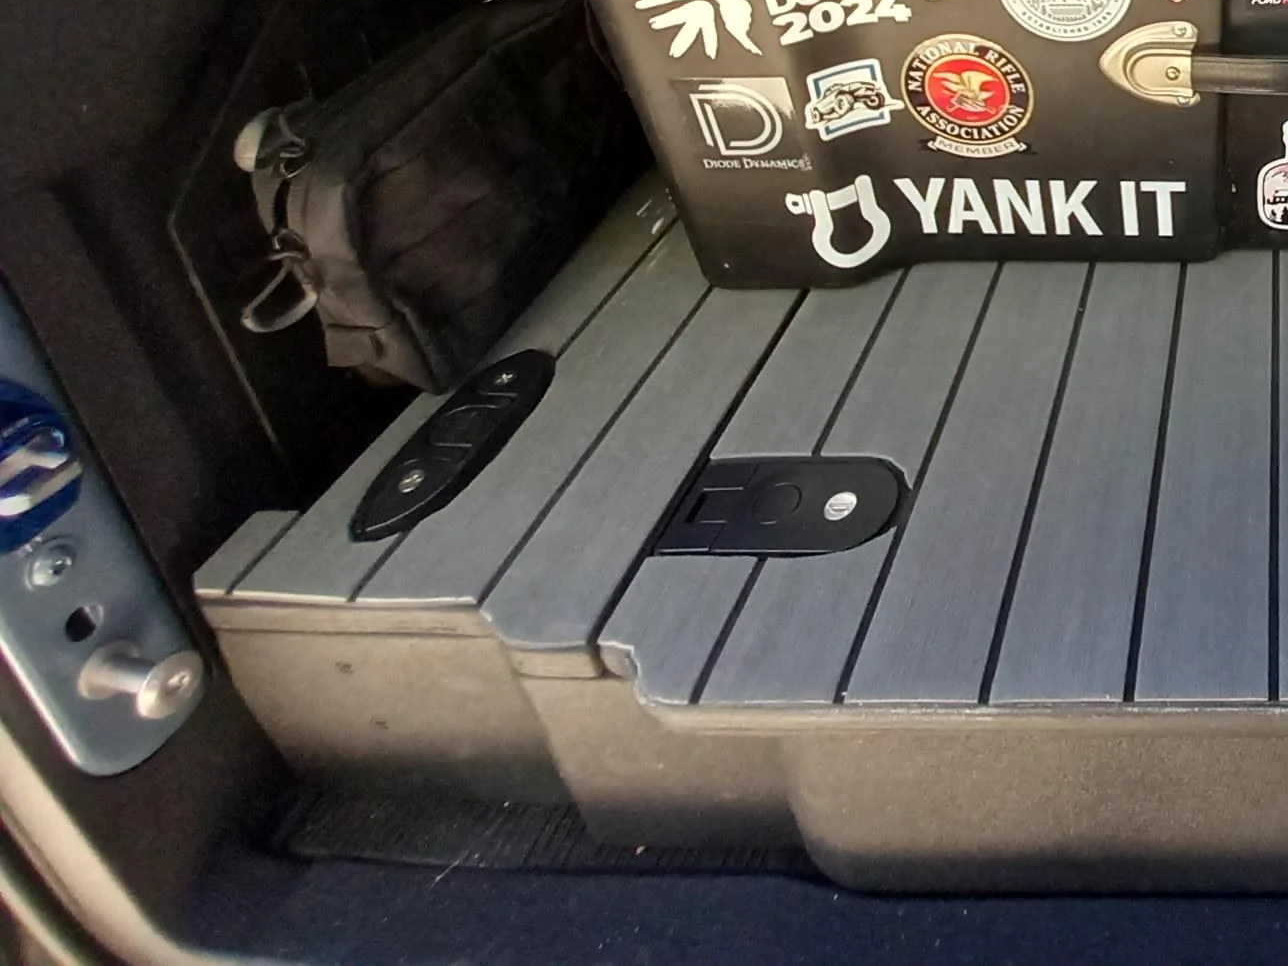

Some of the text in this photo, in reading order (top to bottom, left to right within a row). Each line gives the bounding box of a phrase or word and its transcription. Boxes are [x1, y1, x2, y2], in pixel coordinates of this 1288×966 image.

[908, 41, 1026, 94] NATIONAL RIFLE
[917, 104, 1025, 139] ASSOCIATION
[703, 158, 741, 169] DIODE
[939, 139, 1016, 155] MEMBER
[893, 177, 1187, 236] YANK IT
